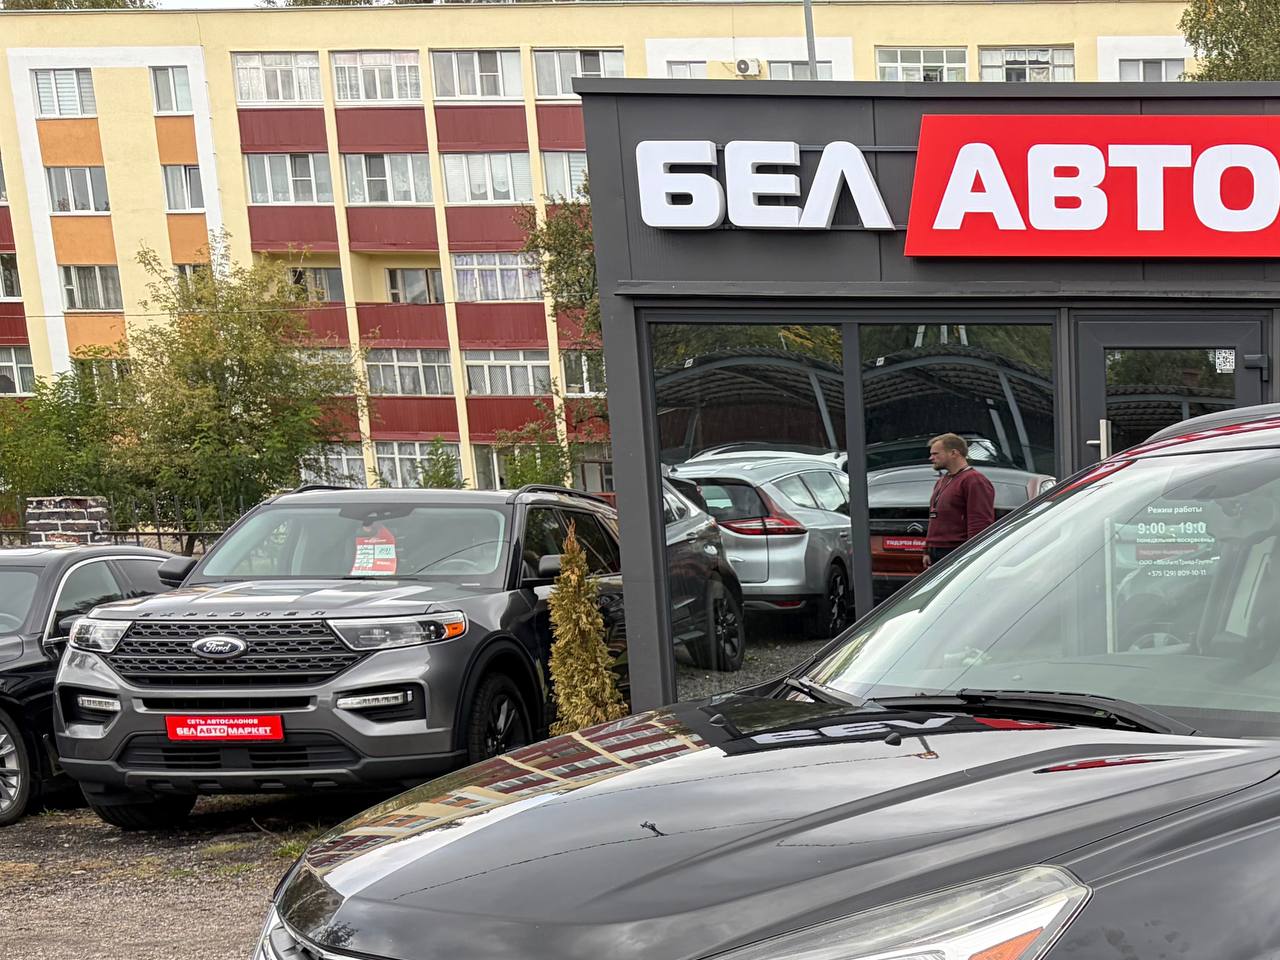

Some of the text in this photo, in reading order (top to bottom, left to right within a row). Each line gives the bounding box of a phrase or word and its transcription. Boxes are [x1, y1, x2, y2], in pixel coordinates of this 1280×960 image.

[635, 140, 896, 230] БЕЛ
[1174, 505, 1203, 515] работы
[1137, 522, 1166, 534] 9:00
[202, 641, 231, 654] Ford
